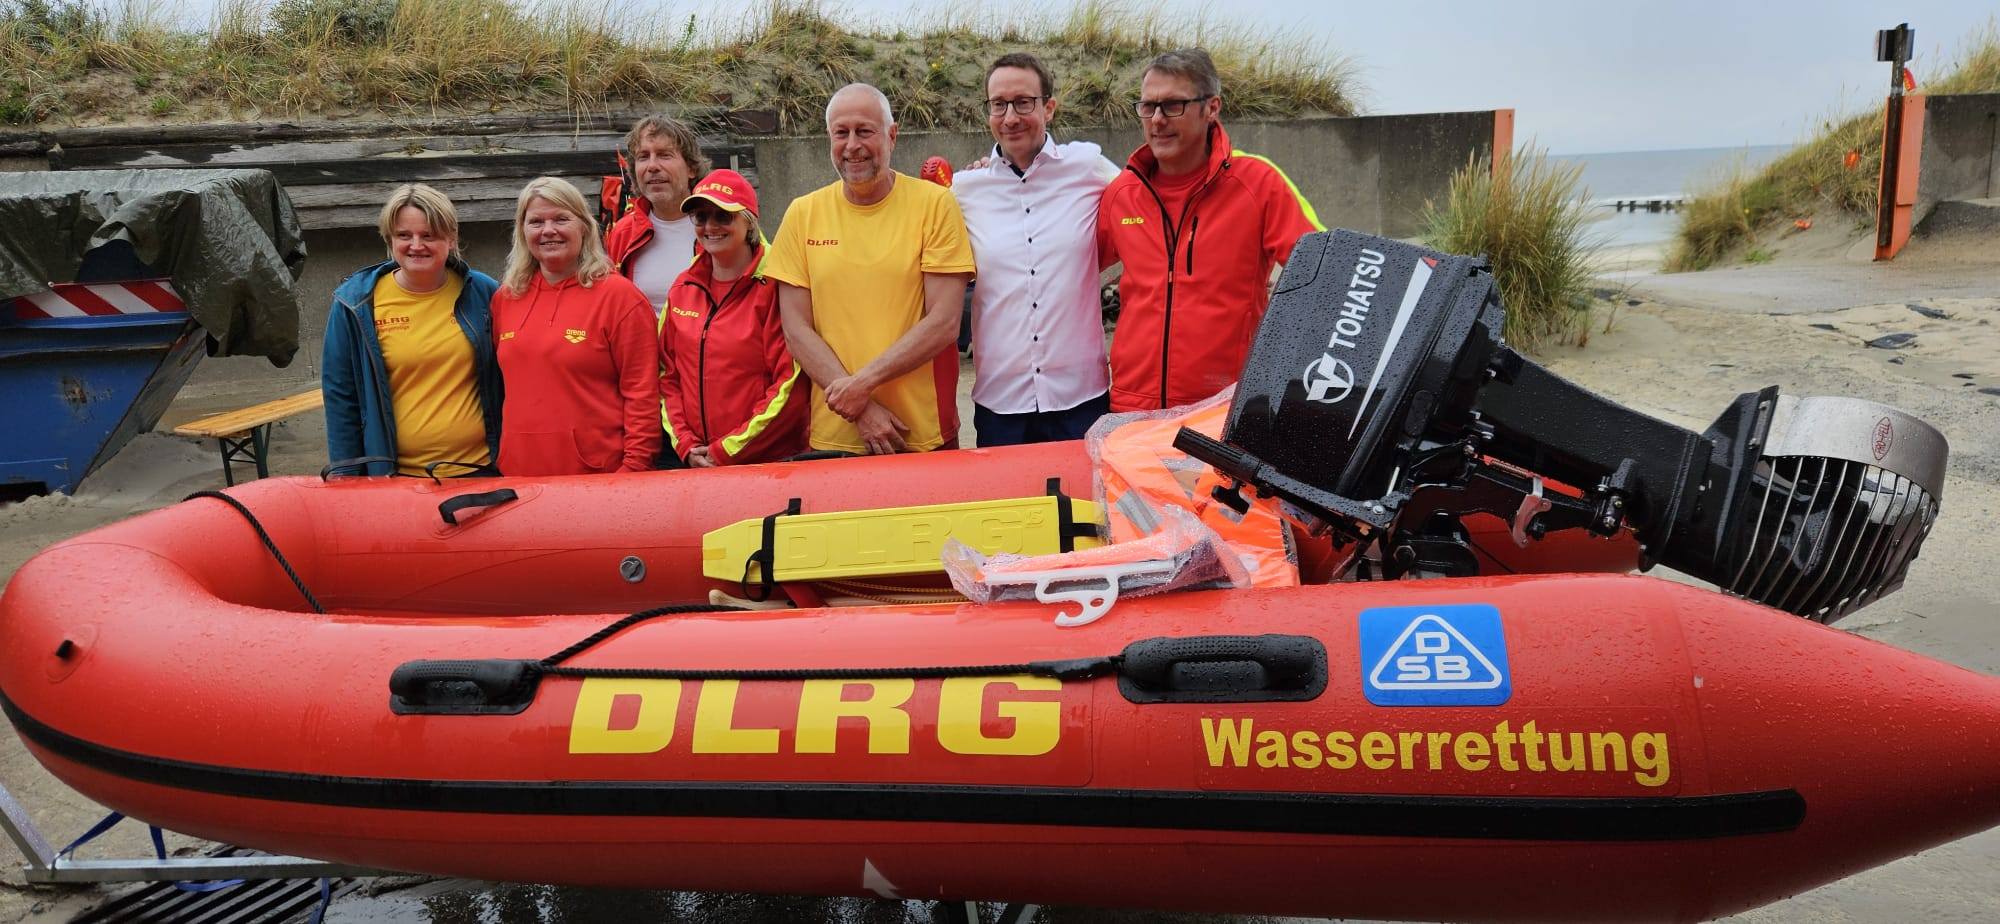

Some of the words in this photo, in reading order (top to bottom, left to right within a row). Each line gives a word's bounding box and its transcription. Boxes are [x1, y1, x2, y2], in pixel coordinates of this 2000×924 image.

[694, 182, 734, 196] DLRG
[1328, 249, 1385, 348] TOHATSU
[672, 306, 700, 318] DLRG
[1415, 631, 1450, 654] D
[1396, 655, 1471, 681] SB
[569, 674, 1063, 756] DLRG
[1200, 718, 1671, 787] Wasserrettung
